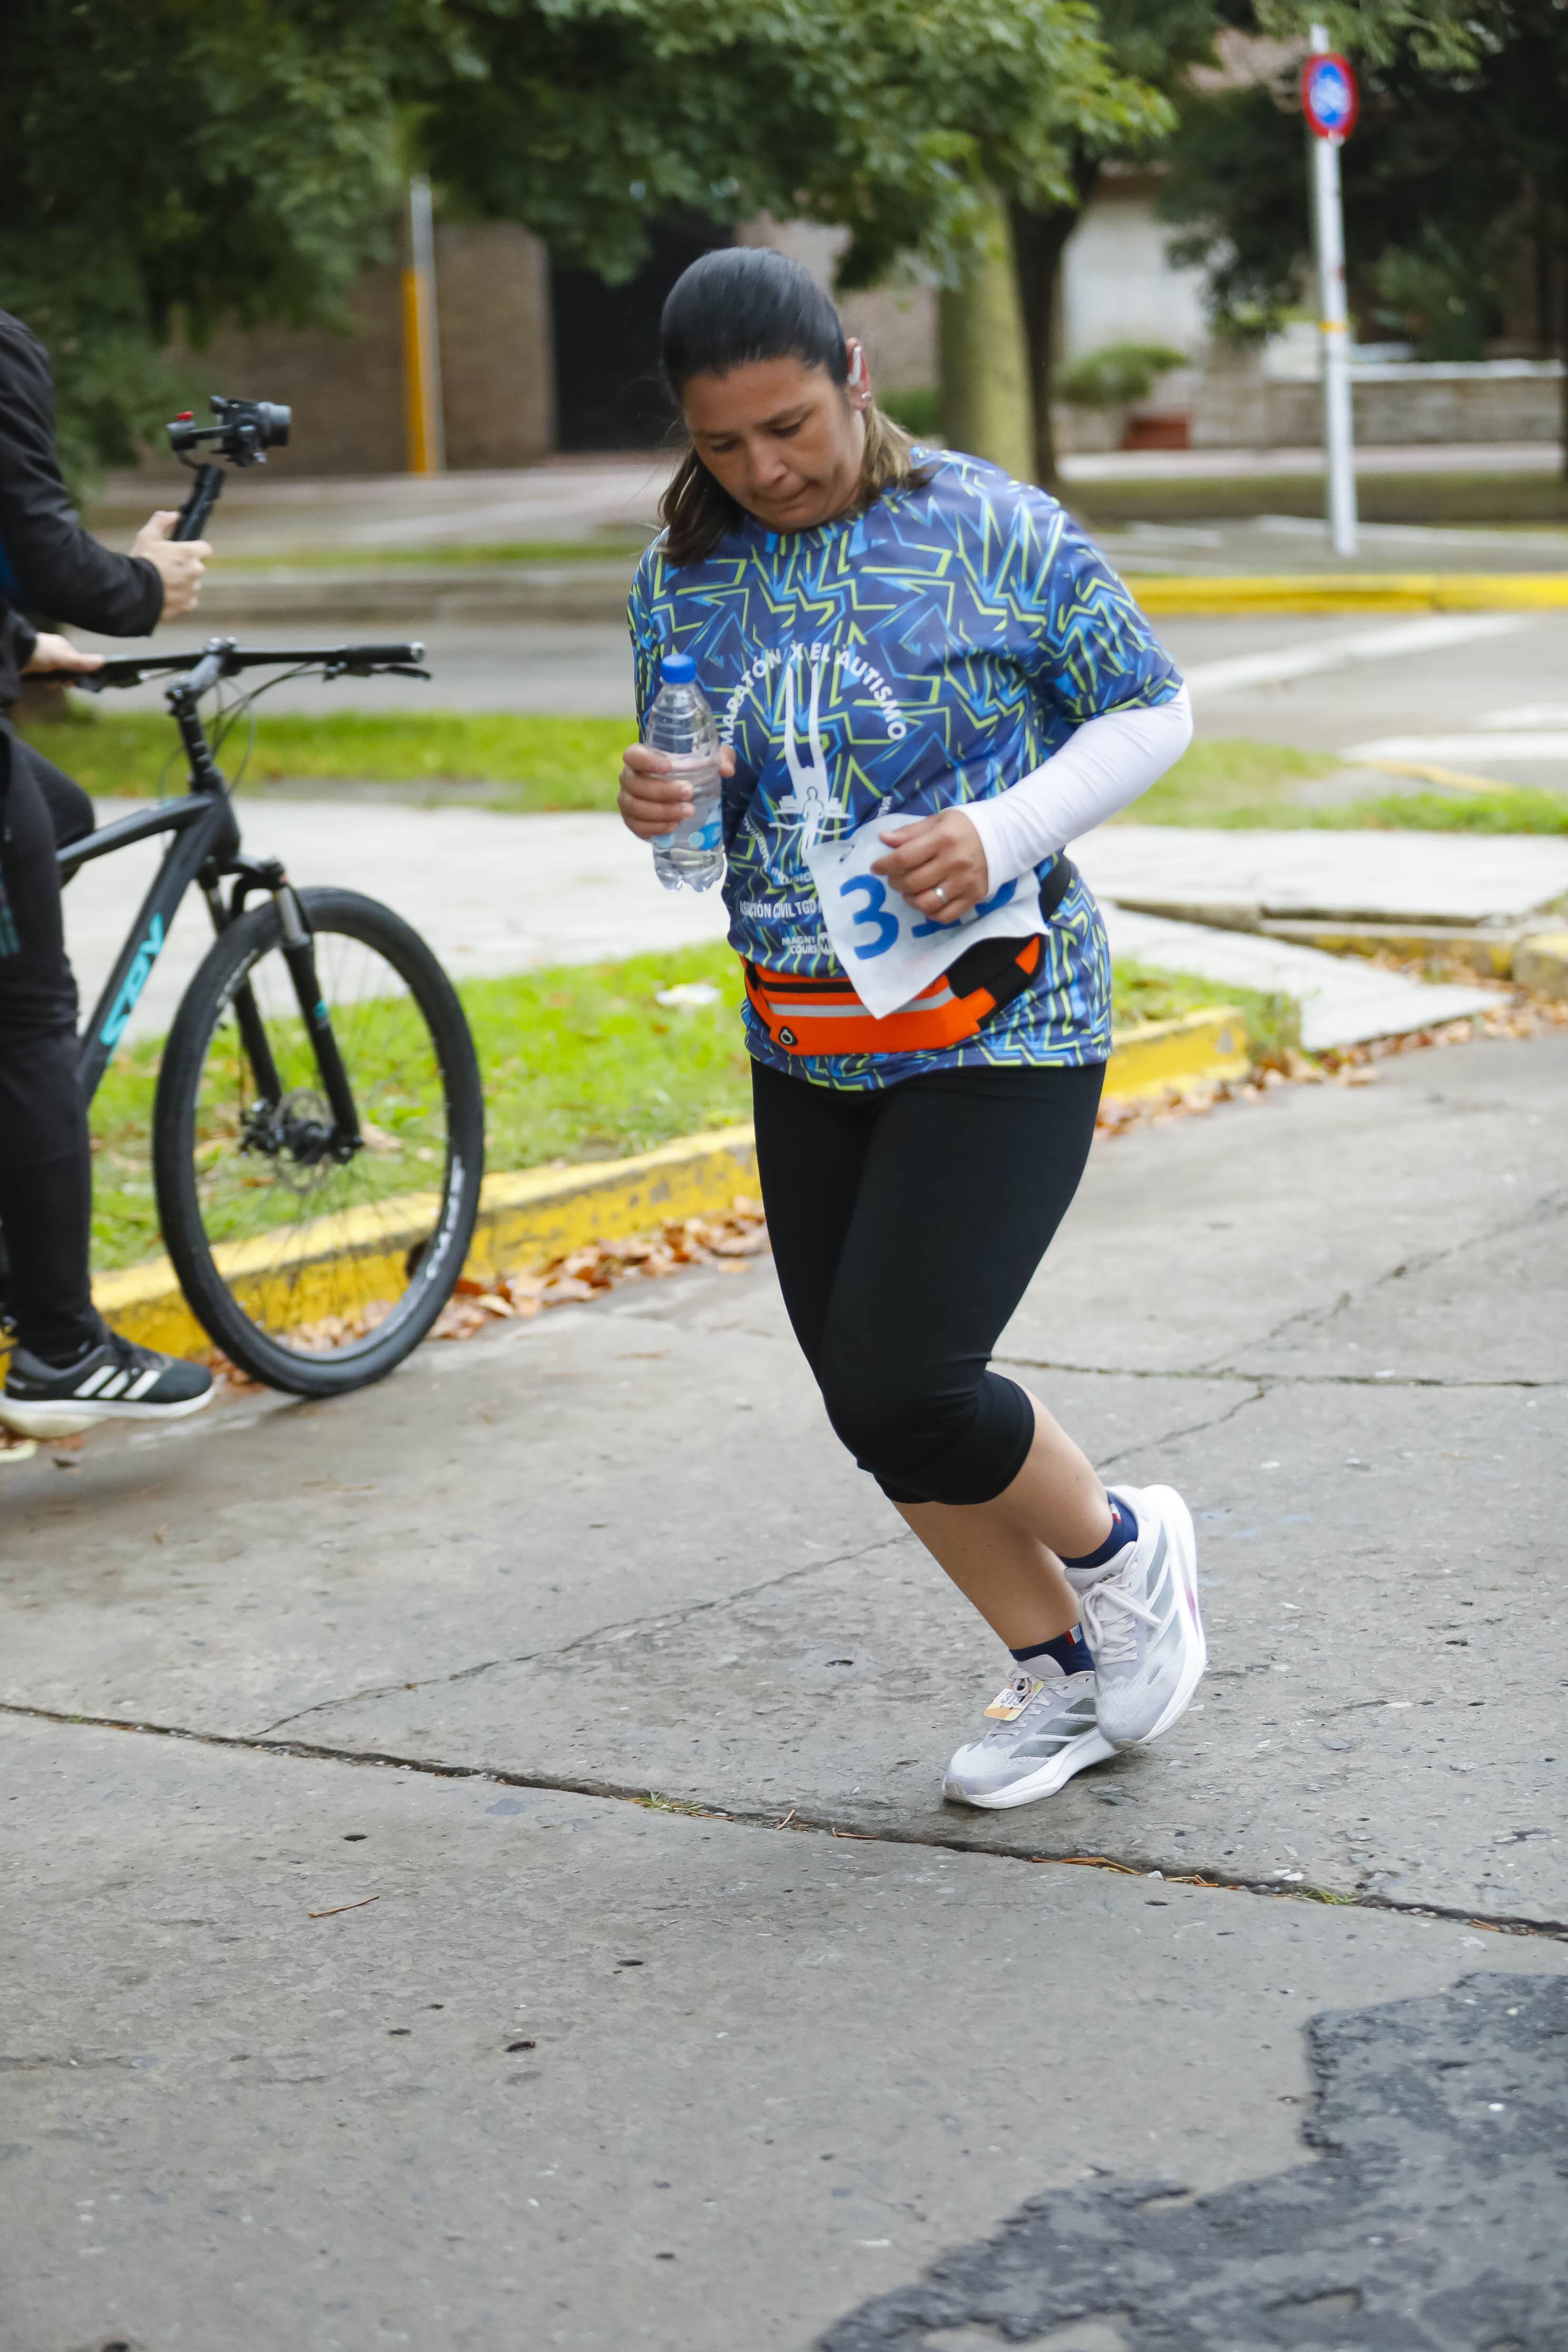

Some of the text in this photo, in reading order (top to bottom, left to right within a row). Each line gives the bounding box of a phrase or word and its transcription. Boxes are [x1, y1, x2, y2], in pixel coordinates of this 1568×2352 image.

[720, 642, 907, 747] MARATÓN X EL AUTISMO
[772, 901, 796, 918] CIVIL
[795, 898, 817, 915] TGD
[781, 936, 816, 946] MAGNY
[790, 944, 817, 955] COURS
